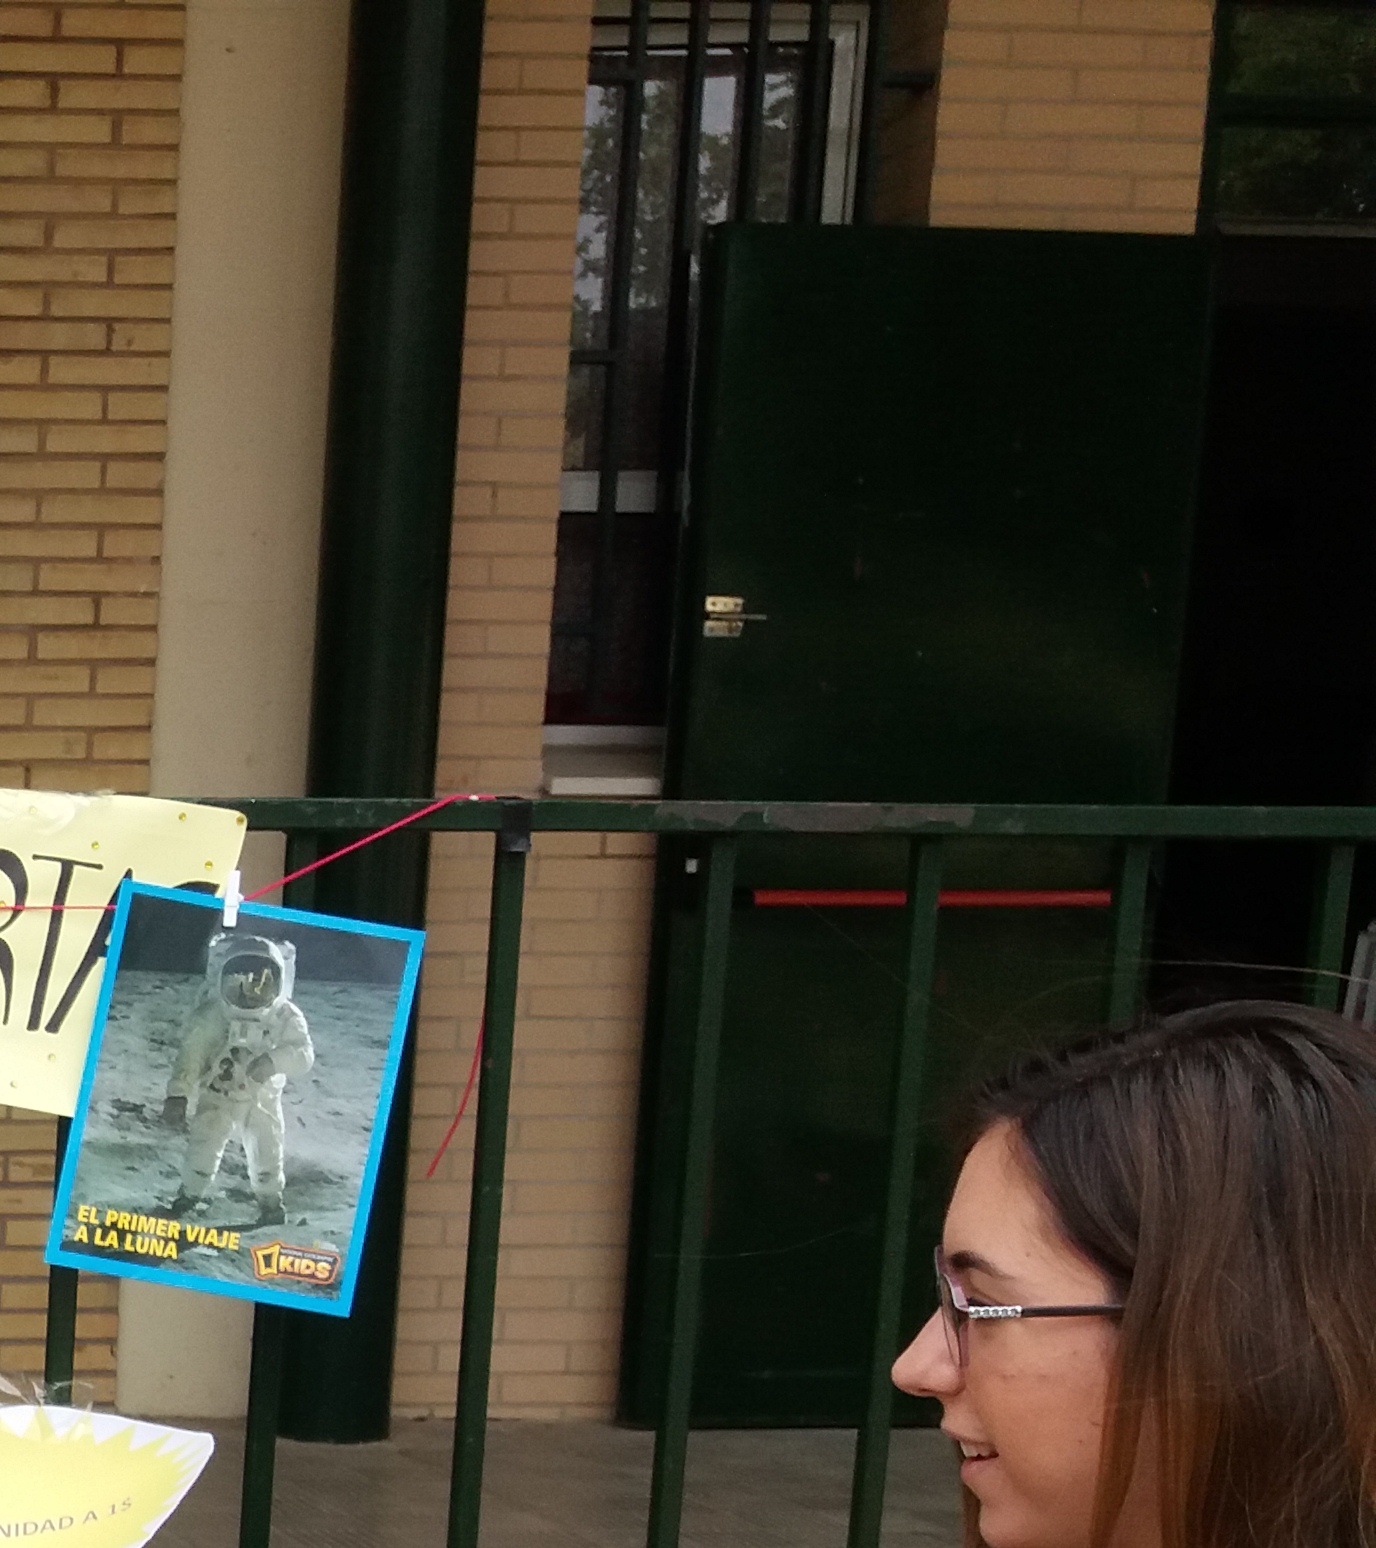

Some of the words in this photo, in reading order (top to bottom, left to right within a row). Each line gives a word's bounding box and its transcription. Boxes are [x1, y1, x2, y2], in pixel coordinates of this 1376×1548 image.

[76, 1204, 99, 1224] EL
[104, 1208, 181, 1240] PRIMER
[184, 1223, 241, 1251] VIAJE
[73, 1225, 89, 1244] A
[93, 1228, 121, 1249] LA
[123, 1232, 179, 1260] LUNA
[279, 1255, 332, 1279] KIDS
[82, 1510, 98, 1525] A
